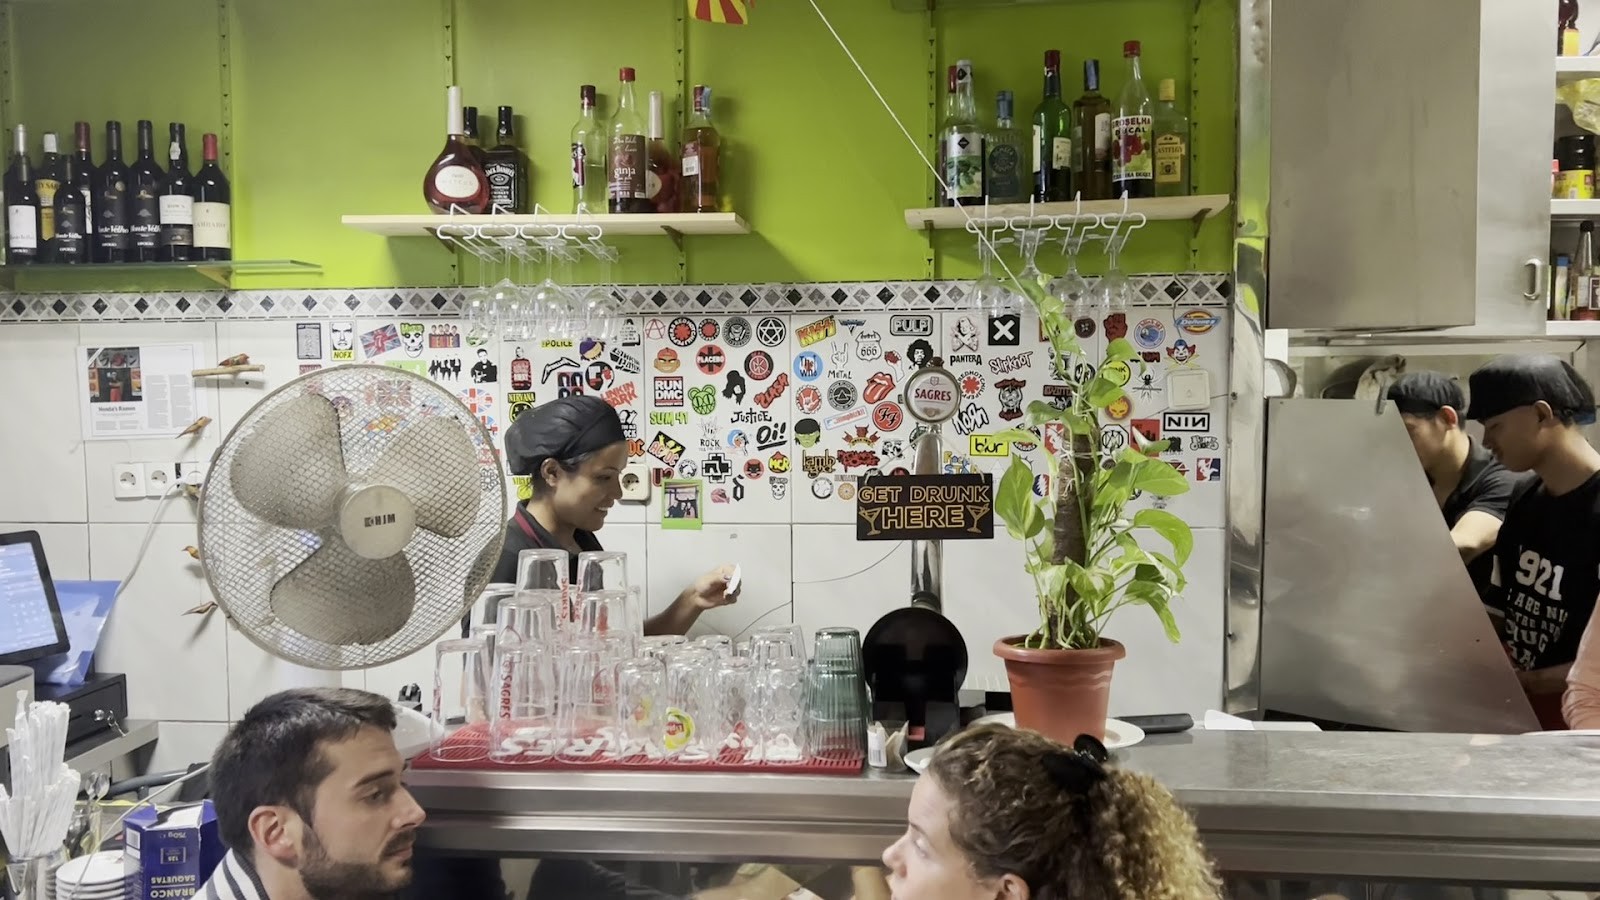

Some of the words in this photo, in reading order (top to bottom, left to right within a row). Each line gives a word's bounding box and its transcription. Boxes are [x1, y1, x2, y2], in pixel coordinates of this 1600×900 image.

[613, 166, 636, 179] ginja
[895, 319, 929, 332] PULP
[333, 351, 353, 359] NOFX
[861, 345, 877, 357] 666
[696, 355, 725, 363] PLACEBO
[950, 354, 982, 366] PANTERA
[655, 380, 682, 390] RUN
[508, 393, 535, 402] NIRVANA
[655, 390, 683, 399] DMC
[914, 388, 952, 402] SAGRES
[650, 411, 674, 426] SUM
[675, 411, 688, 425] 41
[623, 430, 637, 438] OCK
[756, 422, 786, 444] Oi!
[627, 438, 646, 457] DC
[700, 439, 720, 447] ROCK
[975, 438, 1003, 453] blur
[649, 440, 680, 466] AC/DC
[858, 486, 903, 504] GET
[909, 485, 991, 503] DRUNK
[881, 504, 966, 530] HERE
[1515, 549, 1565, 601] 921
[1514, 592, 1541, 616] ARE
[499, 674, 513, 720] SAGRES
[151, 874, 196, 885] SAQUETAS
[150, 888, 196, 900] BRANCO
